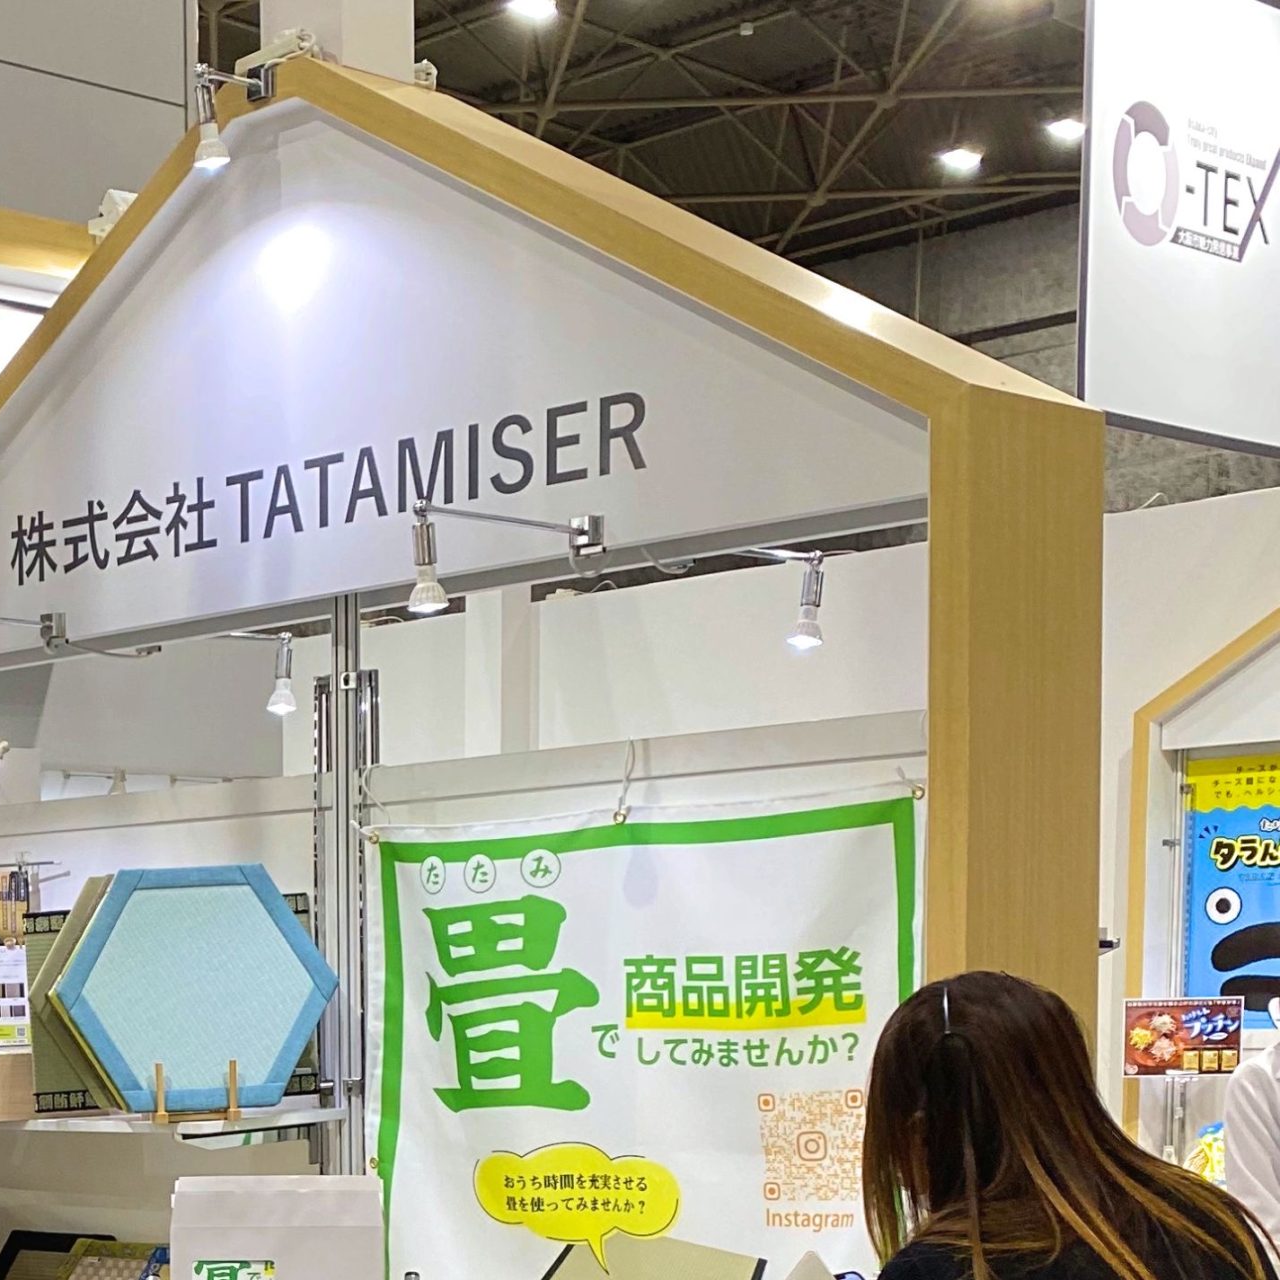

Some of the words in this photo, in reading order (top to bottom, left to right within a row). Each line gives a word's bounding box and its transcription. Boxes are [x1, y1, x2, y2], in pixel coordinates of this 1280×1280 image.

[421, 894, 600, 1113] 畳
[624, 946, 864, 1019] 商品開発
[504, 1174, 648, 1192] おうち時間を充実させる
[766, 1208, 854, 1233] Instagram
